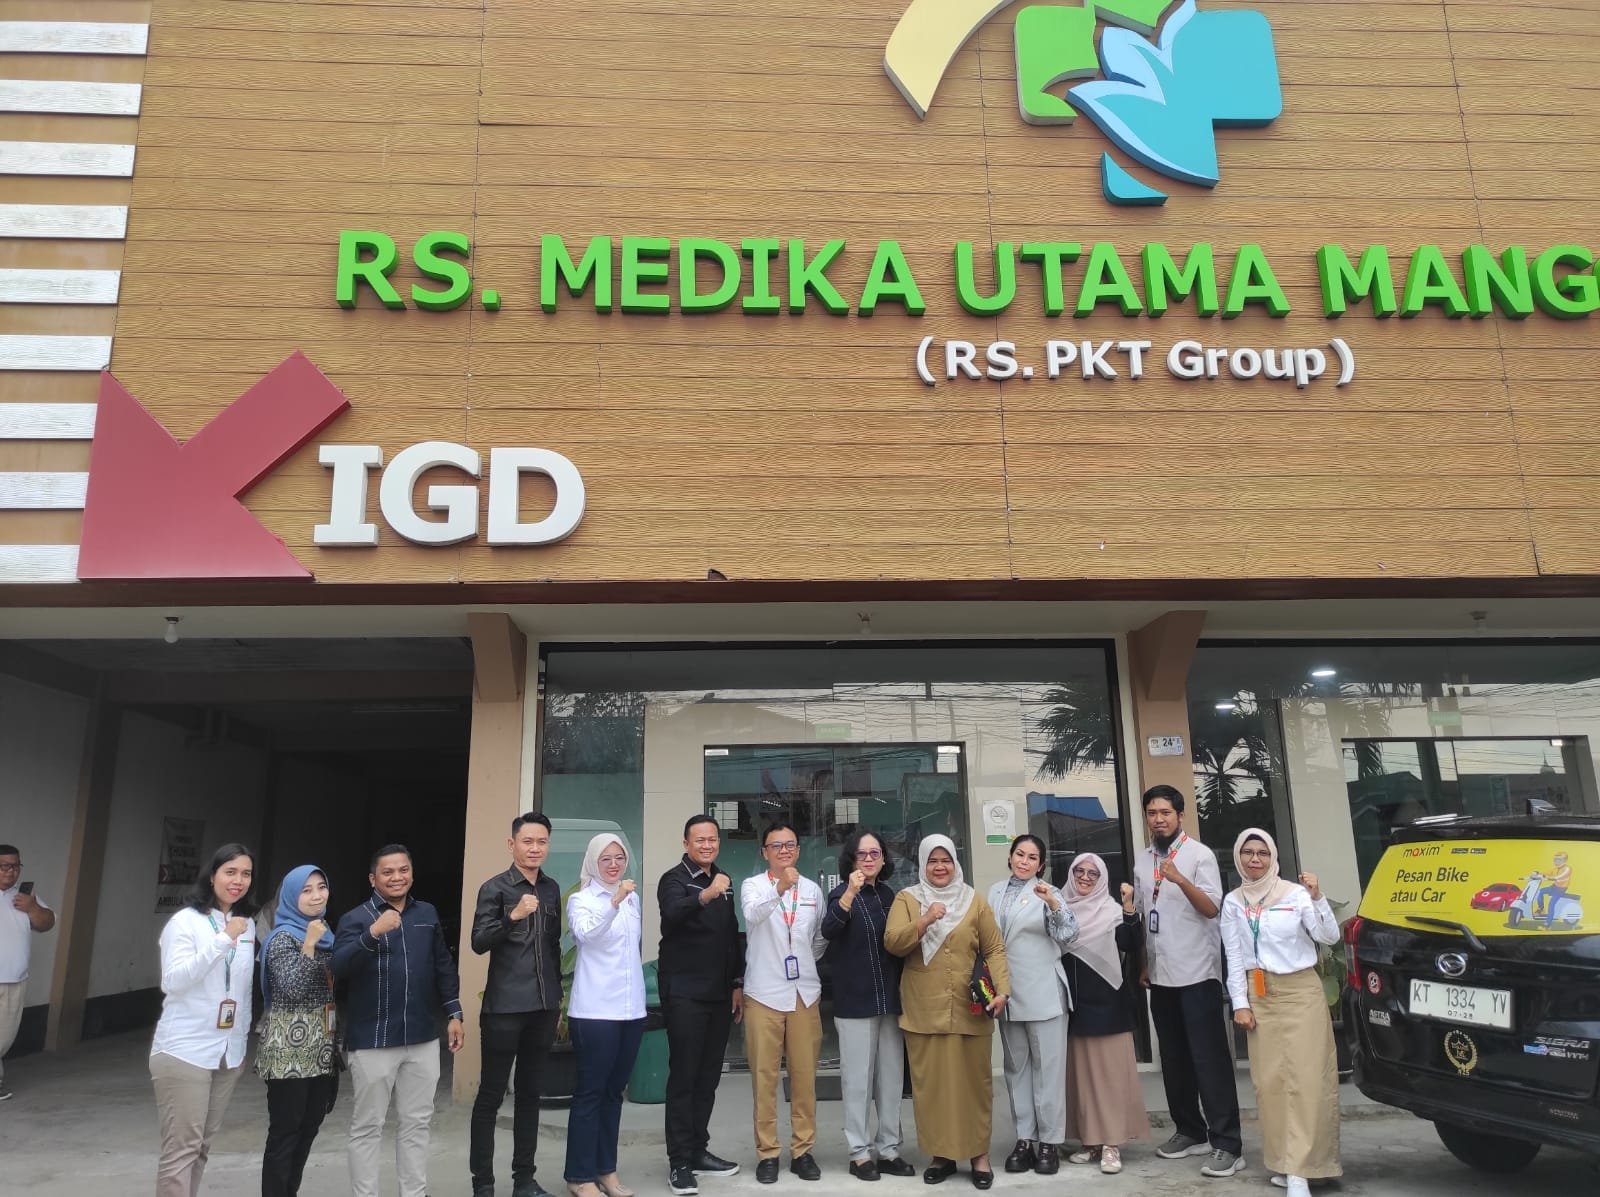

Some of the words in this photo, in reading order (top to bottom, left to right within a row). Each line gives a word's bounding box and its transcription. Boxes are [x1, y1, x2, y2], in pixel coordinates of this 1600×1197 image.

[336, 230, 501, 311] RS.
[540, 234, 926, 316] MEDIKA
[953, 240, 1292, 318] UTAMA
[1316, 243, 1600, 319] MANG
[1046, 340, 1151, 380] PKT
[313, 441, 587, 547] IGD
[1396, 868, 1432, 883] Pesan
[1435, 867, 1470, 883] Bike
[1390, 889, 1417, 903] atau
[1420, 887, 1447, 903] Car
[1413, 983, 1431, 1003] KT
[1446, 987, 1476, 1010] 1334
[1491, 992, 1507, 1015] YV
